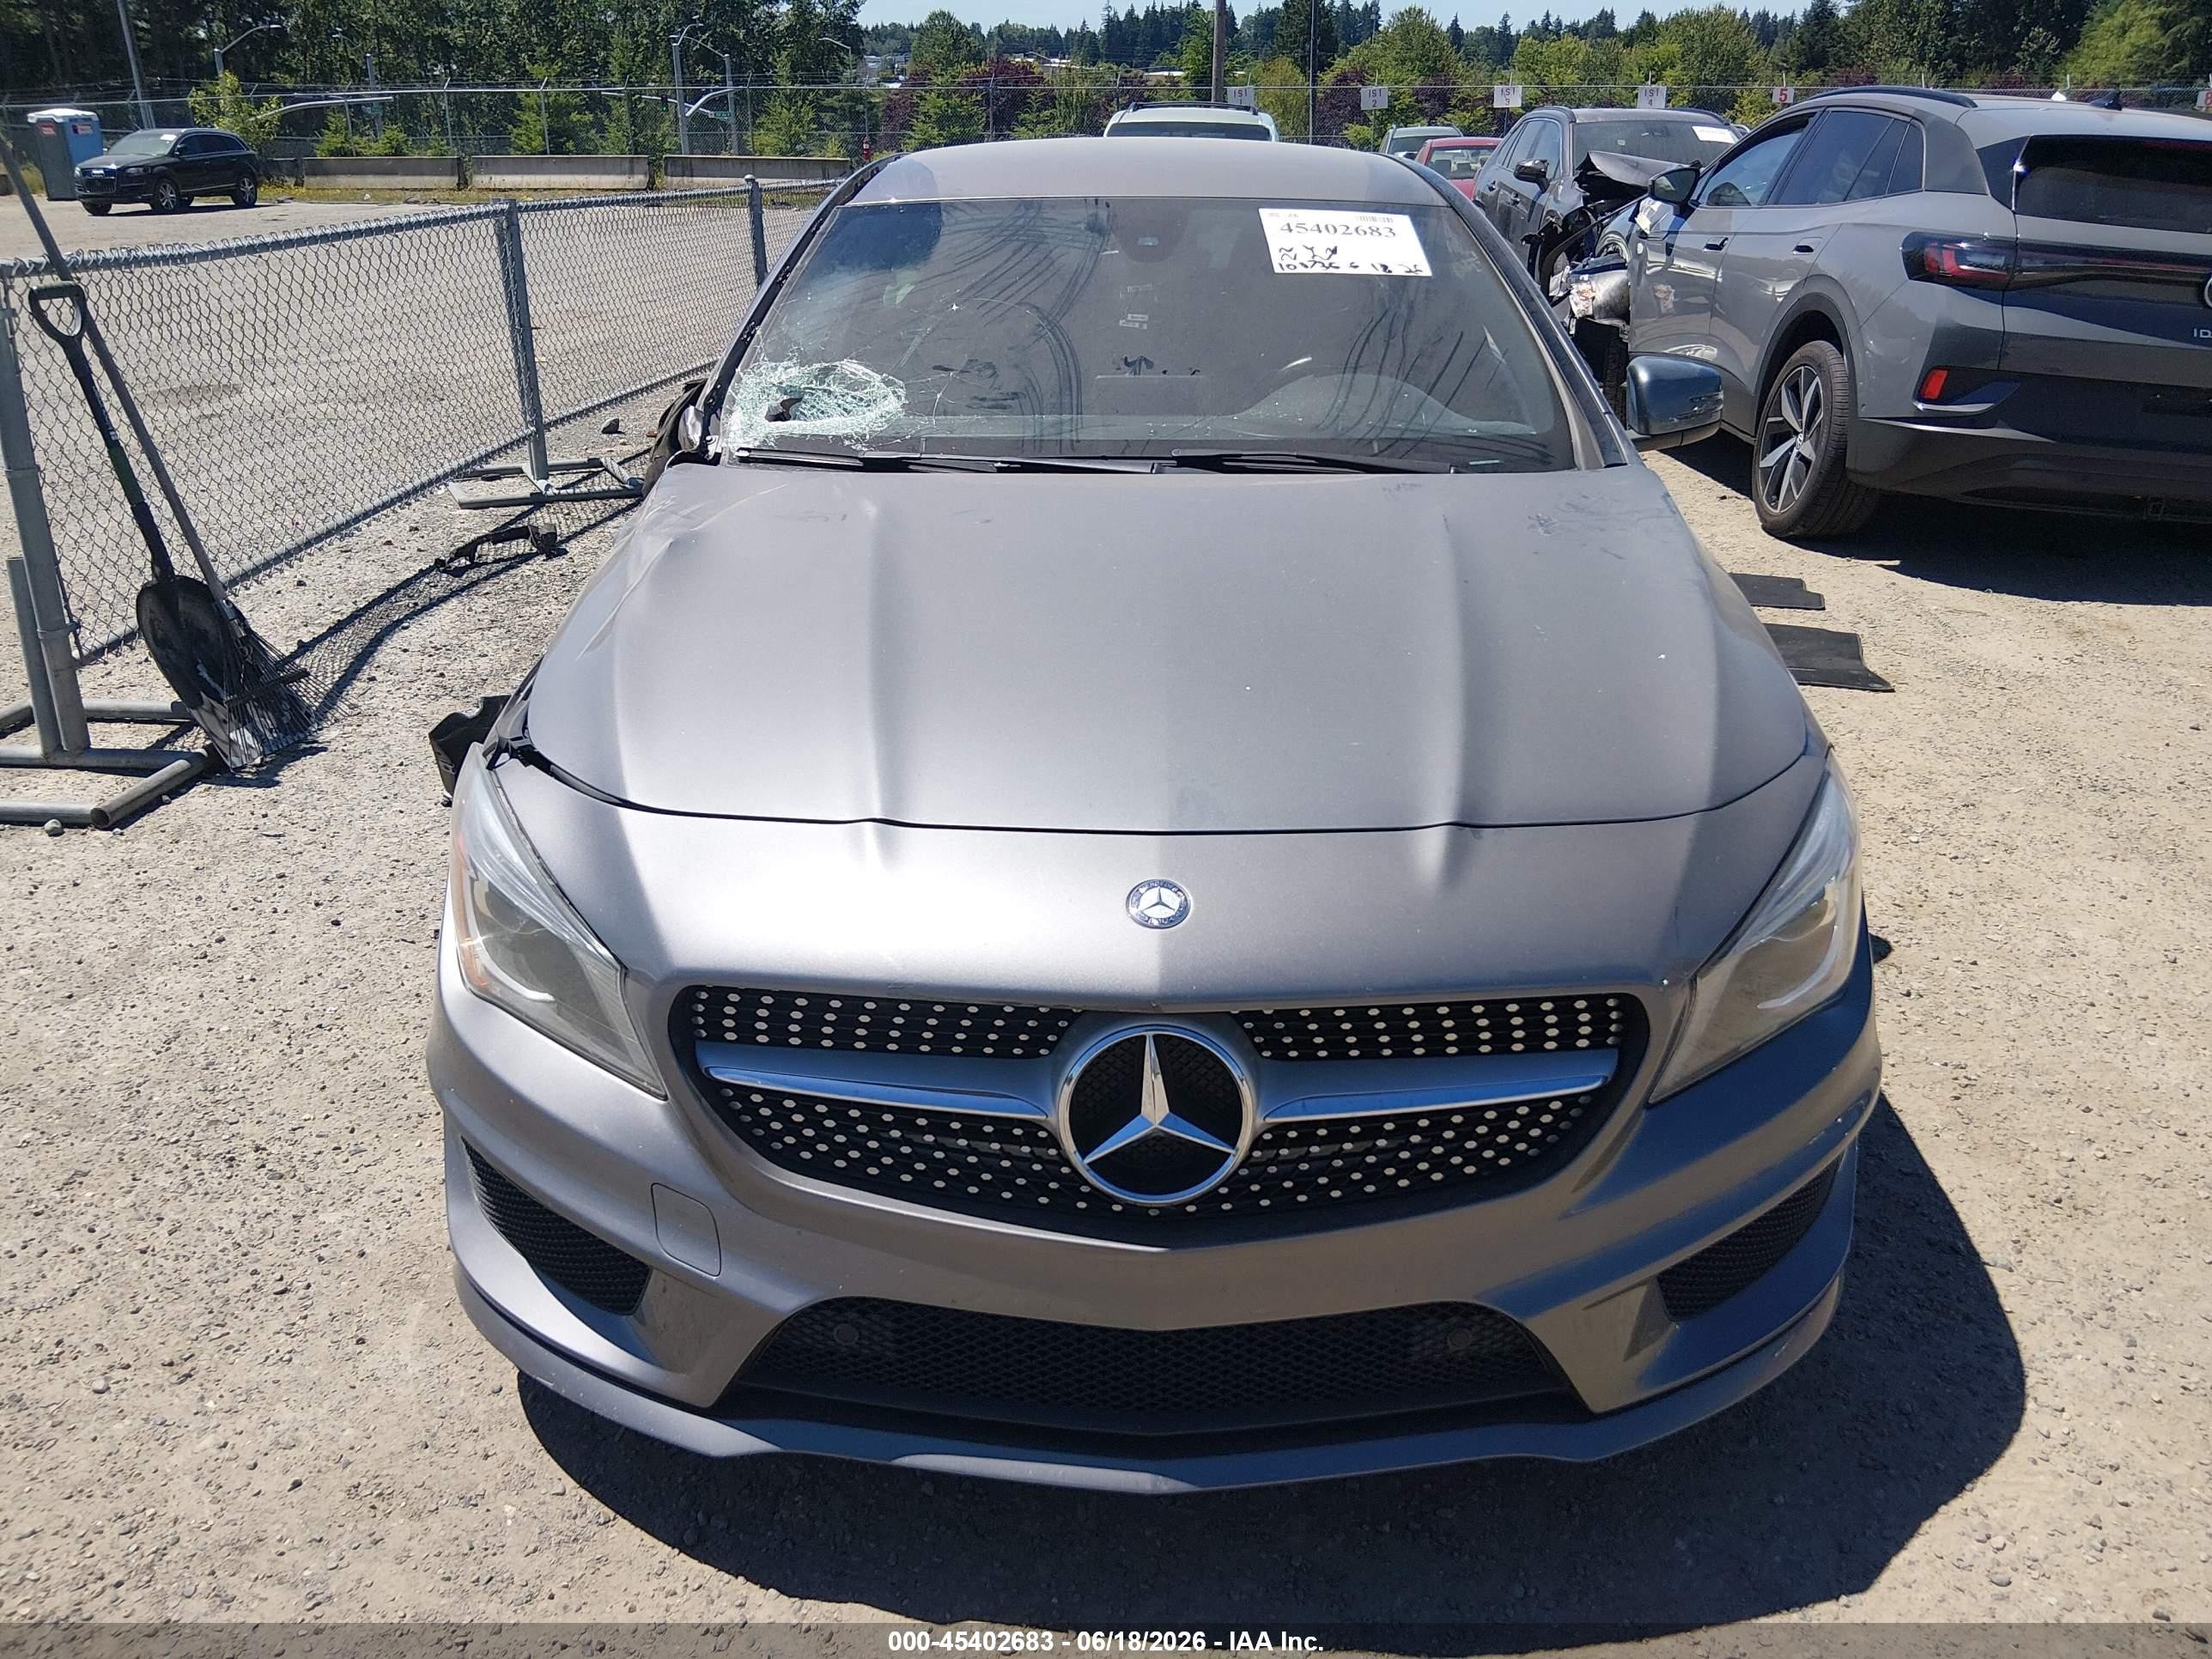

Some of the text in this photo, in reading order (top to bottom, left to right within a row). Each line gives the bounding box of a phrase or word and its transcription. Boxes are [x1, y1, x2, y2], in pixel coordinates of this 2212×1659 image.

[1504, 96, 1510, 106] 3
[1778, 88, 1788, 102] 5
[1371, 99, 1377, 107] 2
[1279, 222, 1397, 239] 45402683
